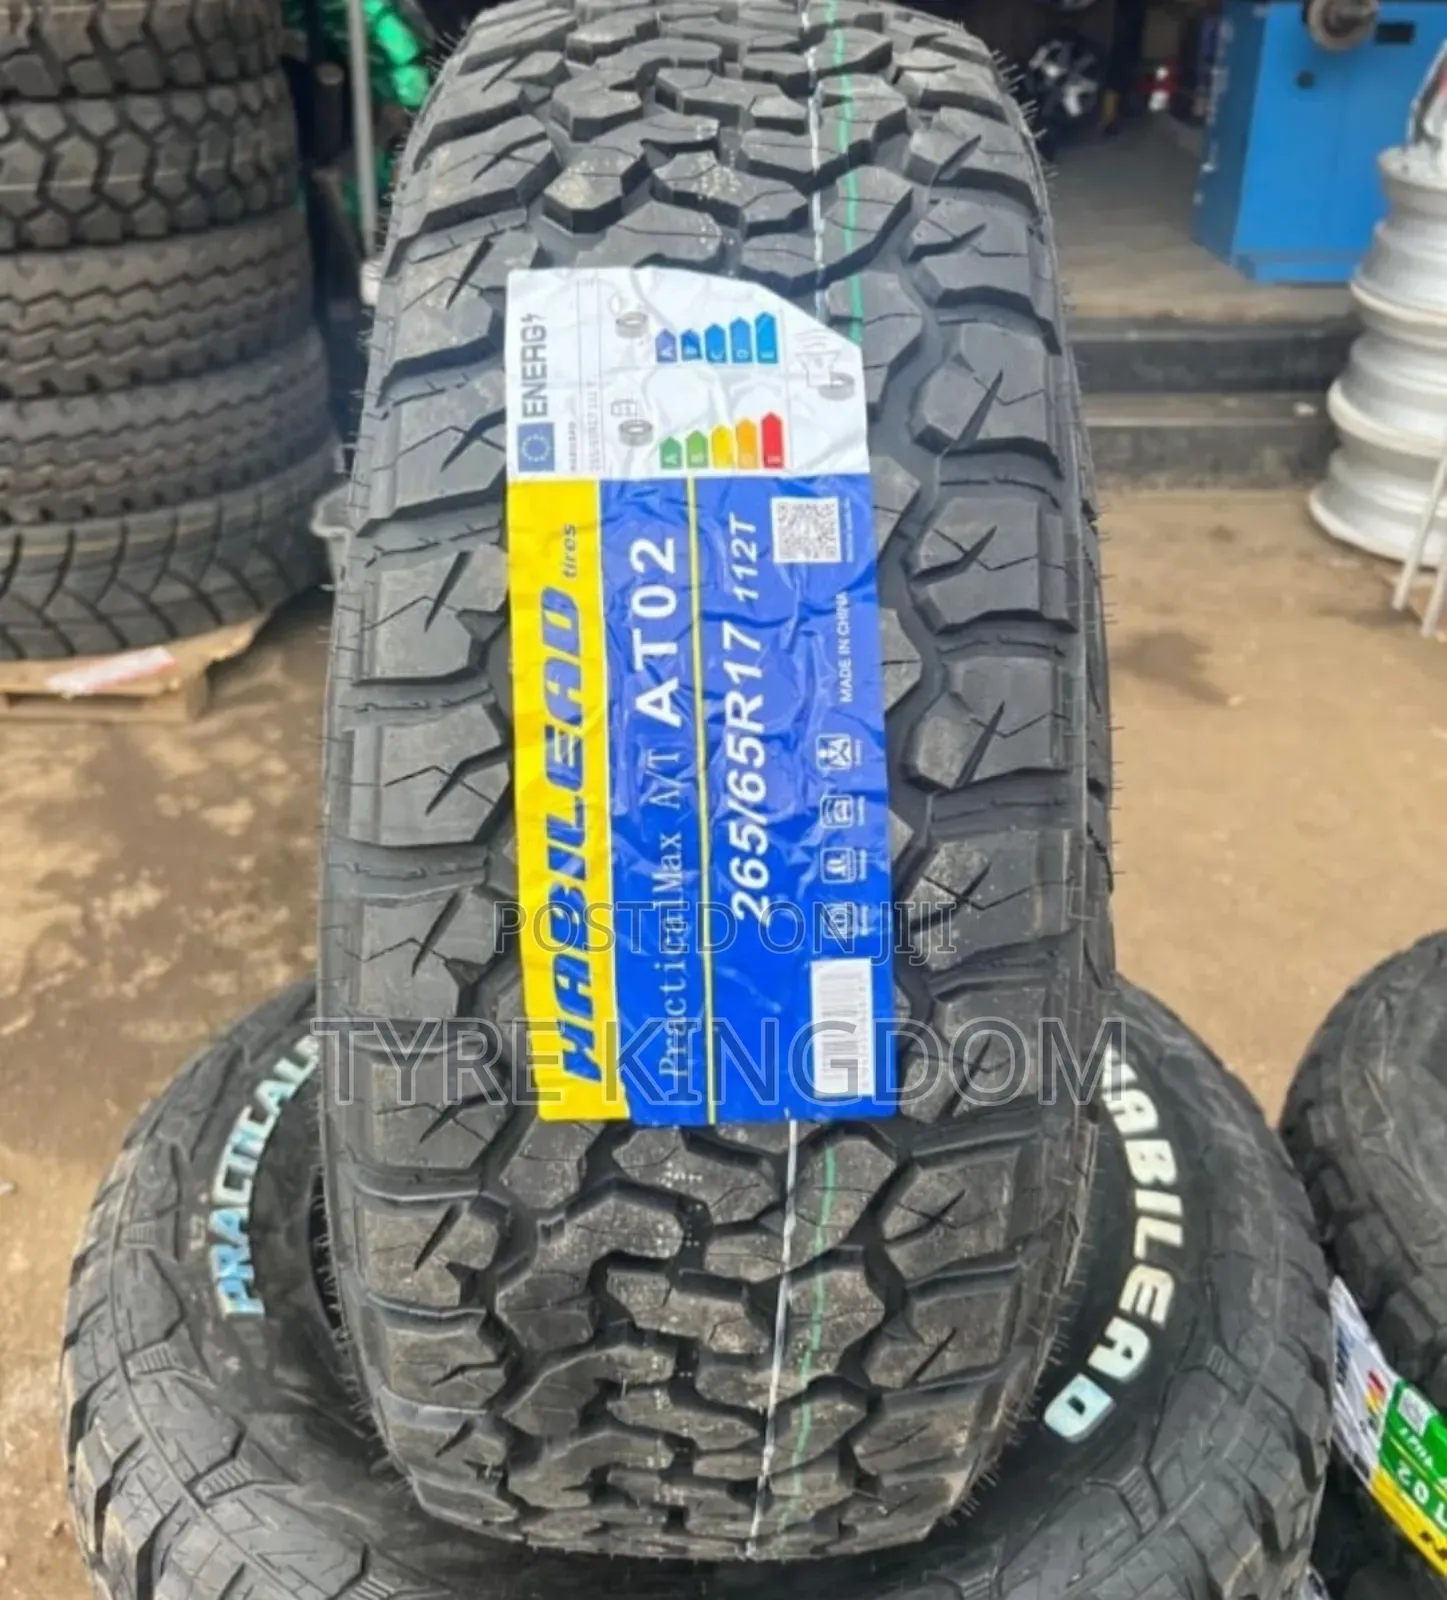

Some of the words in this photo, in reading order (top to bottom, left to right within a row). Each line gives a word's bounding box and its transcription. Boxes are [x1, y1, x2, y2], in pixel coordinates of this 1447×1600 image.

[729, 511, 760, 603] 112T
[629, 536, 682, 728] AT02
[837, 637, 851, 655] IN
[838, 658, 853, 703] MADE
[540, 585, 602, 1083] HABILEAD
[721, 620, 772, 928] 265/65R17
